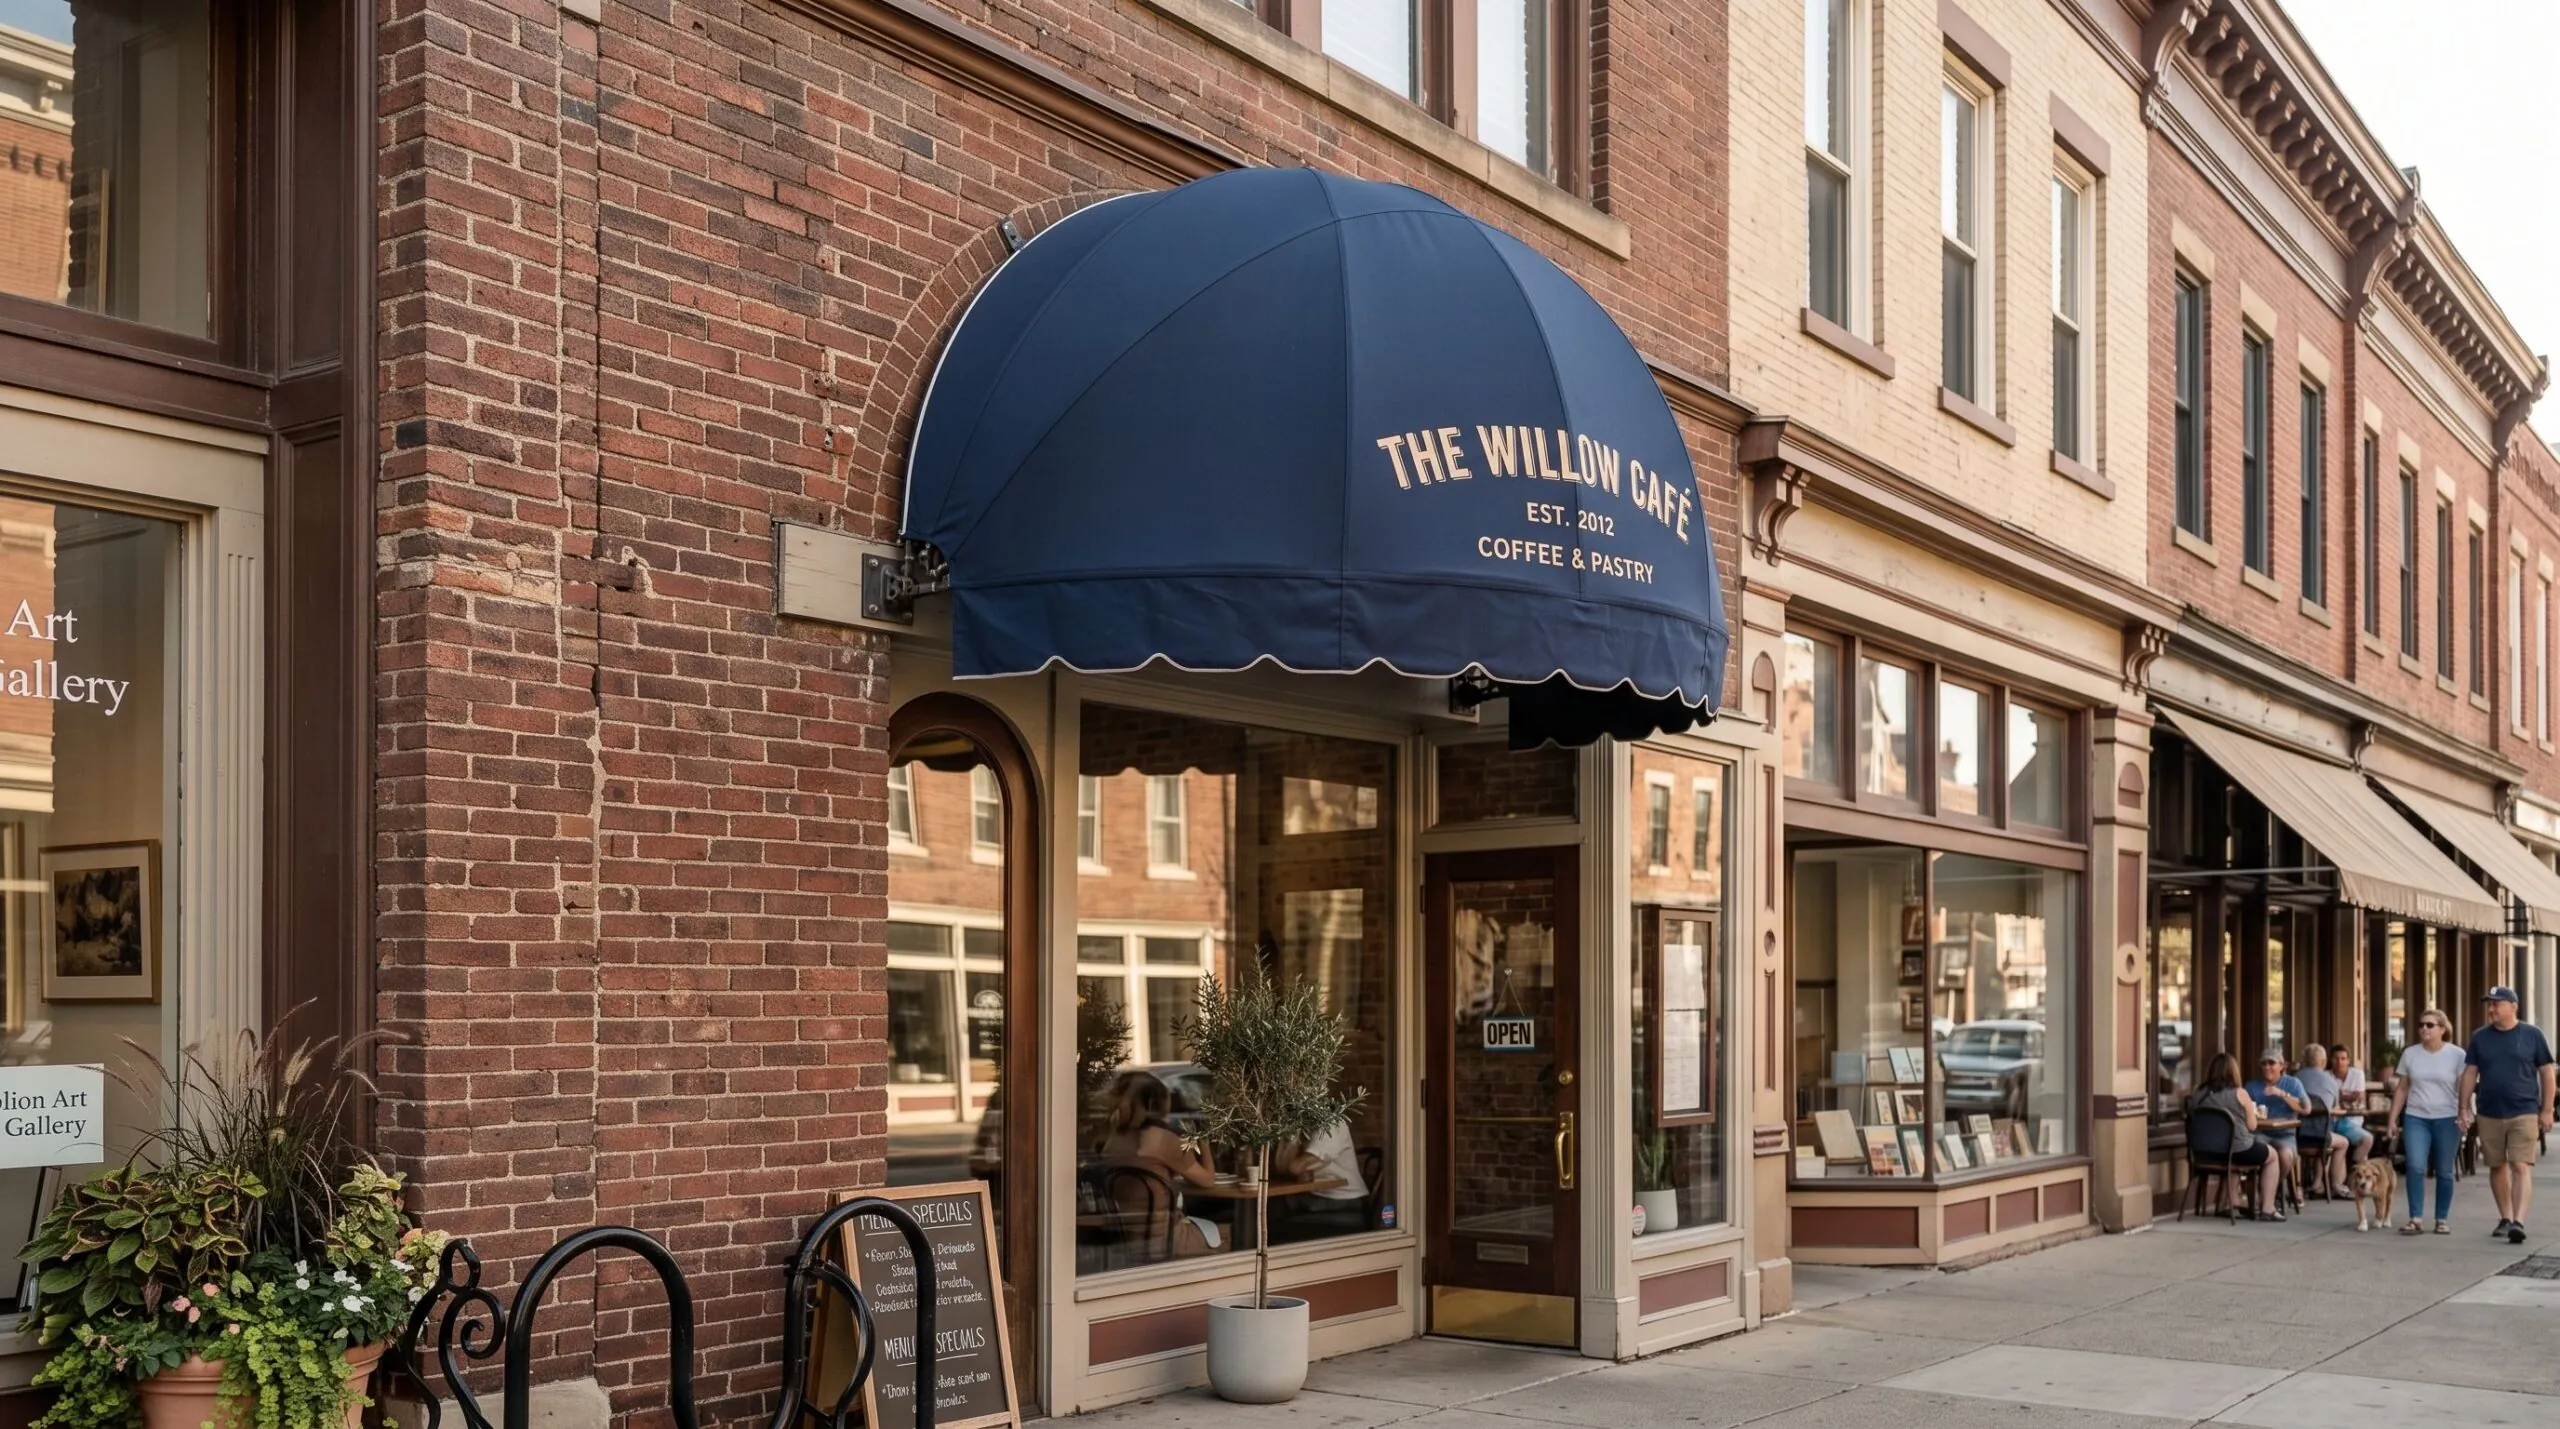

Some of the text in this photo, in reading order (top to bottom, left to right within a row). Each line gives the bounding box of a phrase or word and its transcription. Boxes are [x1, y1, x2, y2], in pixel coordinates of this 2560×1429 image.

[1376, 425, 1693, 545] THE WILLOW CAFÉ
[1526, 502, 1615, 537] EST. 2012
[1478, 536, 1654, 585] COFFEE & PASTRY
[4, 599, 78, 643] Art
[0, 658, 130, 716] allery
[1487, 1022, 1531, 1045] OPEN
[0, 1090, 87, 1110] lion Art
[5, 1115, 86, 1139] Gallery
[912, 1200, 972, 1224] SPECIALS
